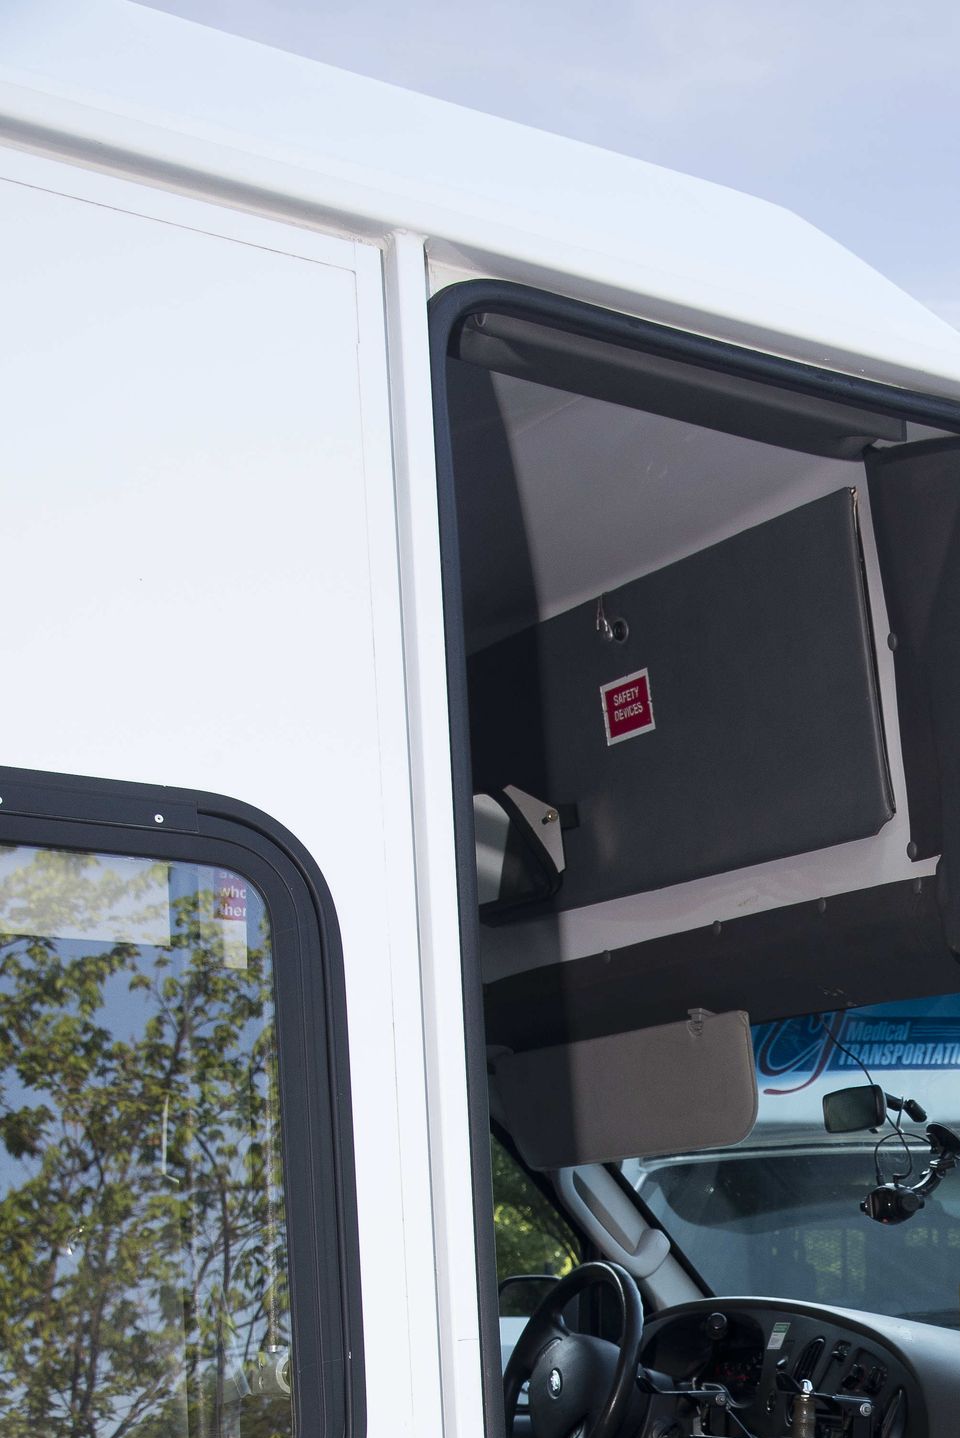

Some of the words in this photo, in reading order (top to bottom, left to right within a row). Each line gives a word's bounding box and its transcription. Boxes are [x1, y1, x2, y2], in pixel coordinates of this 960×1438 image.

[613, 686, 639, 706] SAFETY
[614, 702, 643, 722] DEVICES
[846, 1021, 911, 1041] Medical
